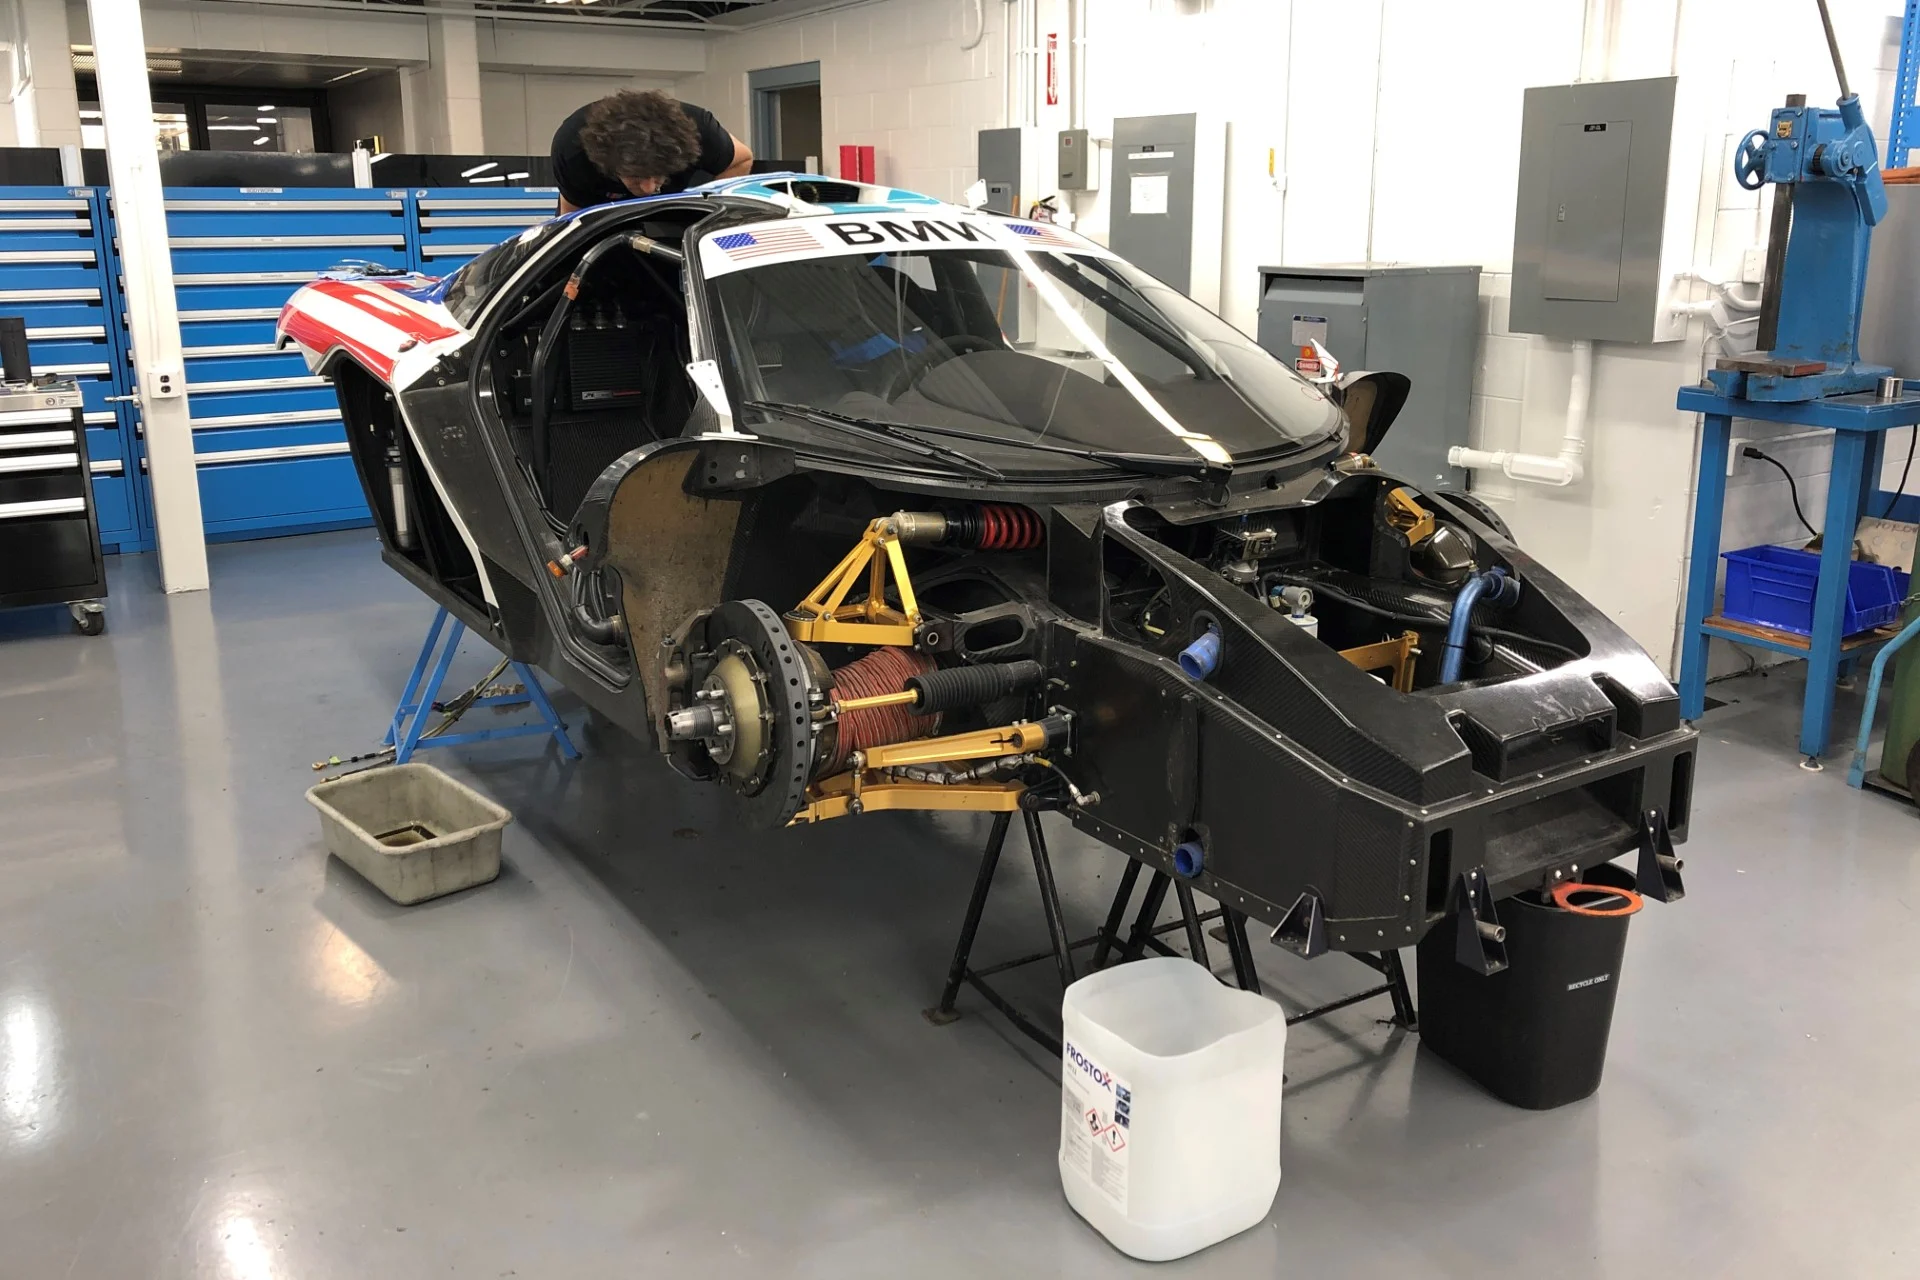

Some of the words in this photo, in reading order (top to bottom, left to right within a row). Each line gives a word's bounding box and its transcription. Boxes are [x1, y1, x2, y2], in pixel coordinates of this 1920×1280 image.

[825, 220, 997, 246] BMW
[1568, 979, 1594, 990] RECYCLE
[1594, 974, 1610, 984] ONLY
[1066, 1042, 1112, 1093] FROSTOX
